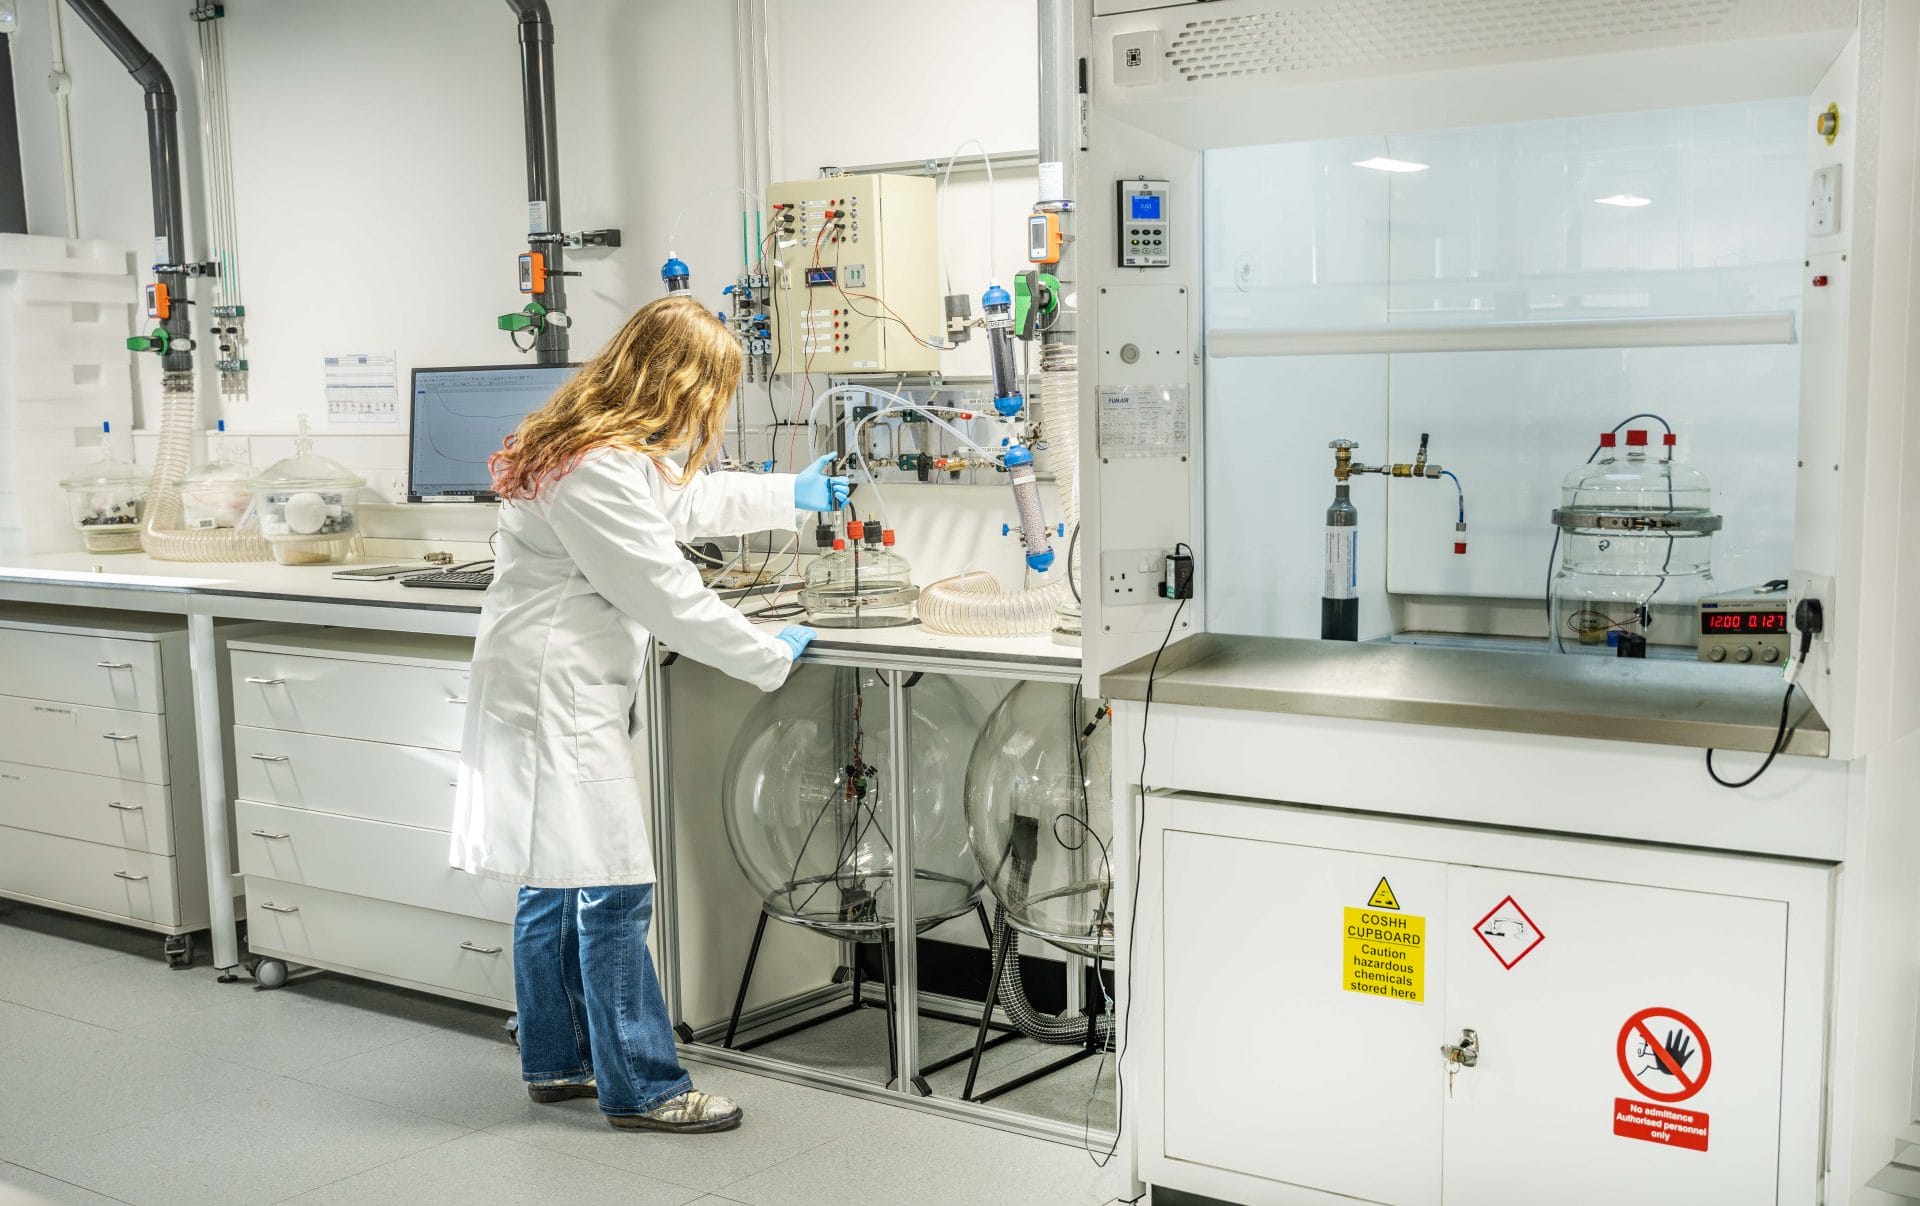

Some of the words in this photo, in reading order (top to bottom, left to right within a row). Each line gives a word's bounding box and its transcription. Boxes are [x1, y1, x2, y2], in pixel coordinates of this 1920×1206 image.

[1710, 615, 1740, 628] 12.00
[1748, 615, 1784, 628] 0.127
[1361, 913, 1407, 929] COSHH
[1348, 925, 1421, 945] CUPBOARD
[1361, 944, 1406, 960] Caution
[1354, 955, 1414, 974] hazardous
[1354, 968, 1413, 986] chemicals
[1350, 981, 1387, 995] stored
[1391, 986, 1416, 999] here
[1630, 1104, 1643, 1113] No
[1645, 1107, 1694, 1123] admittance
[1616, 1112, 1662, 1128] Authorised
[1663, 1122, 1707, 1136] personnel
[1651, 1130, 1671, 1141] only
